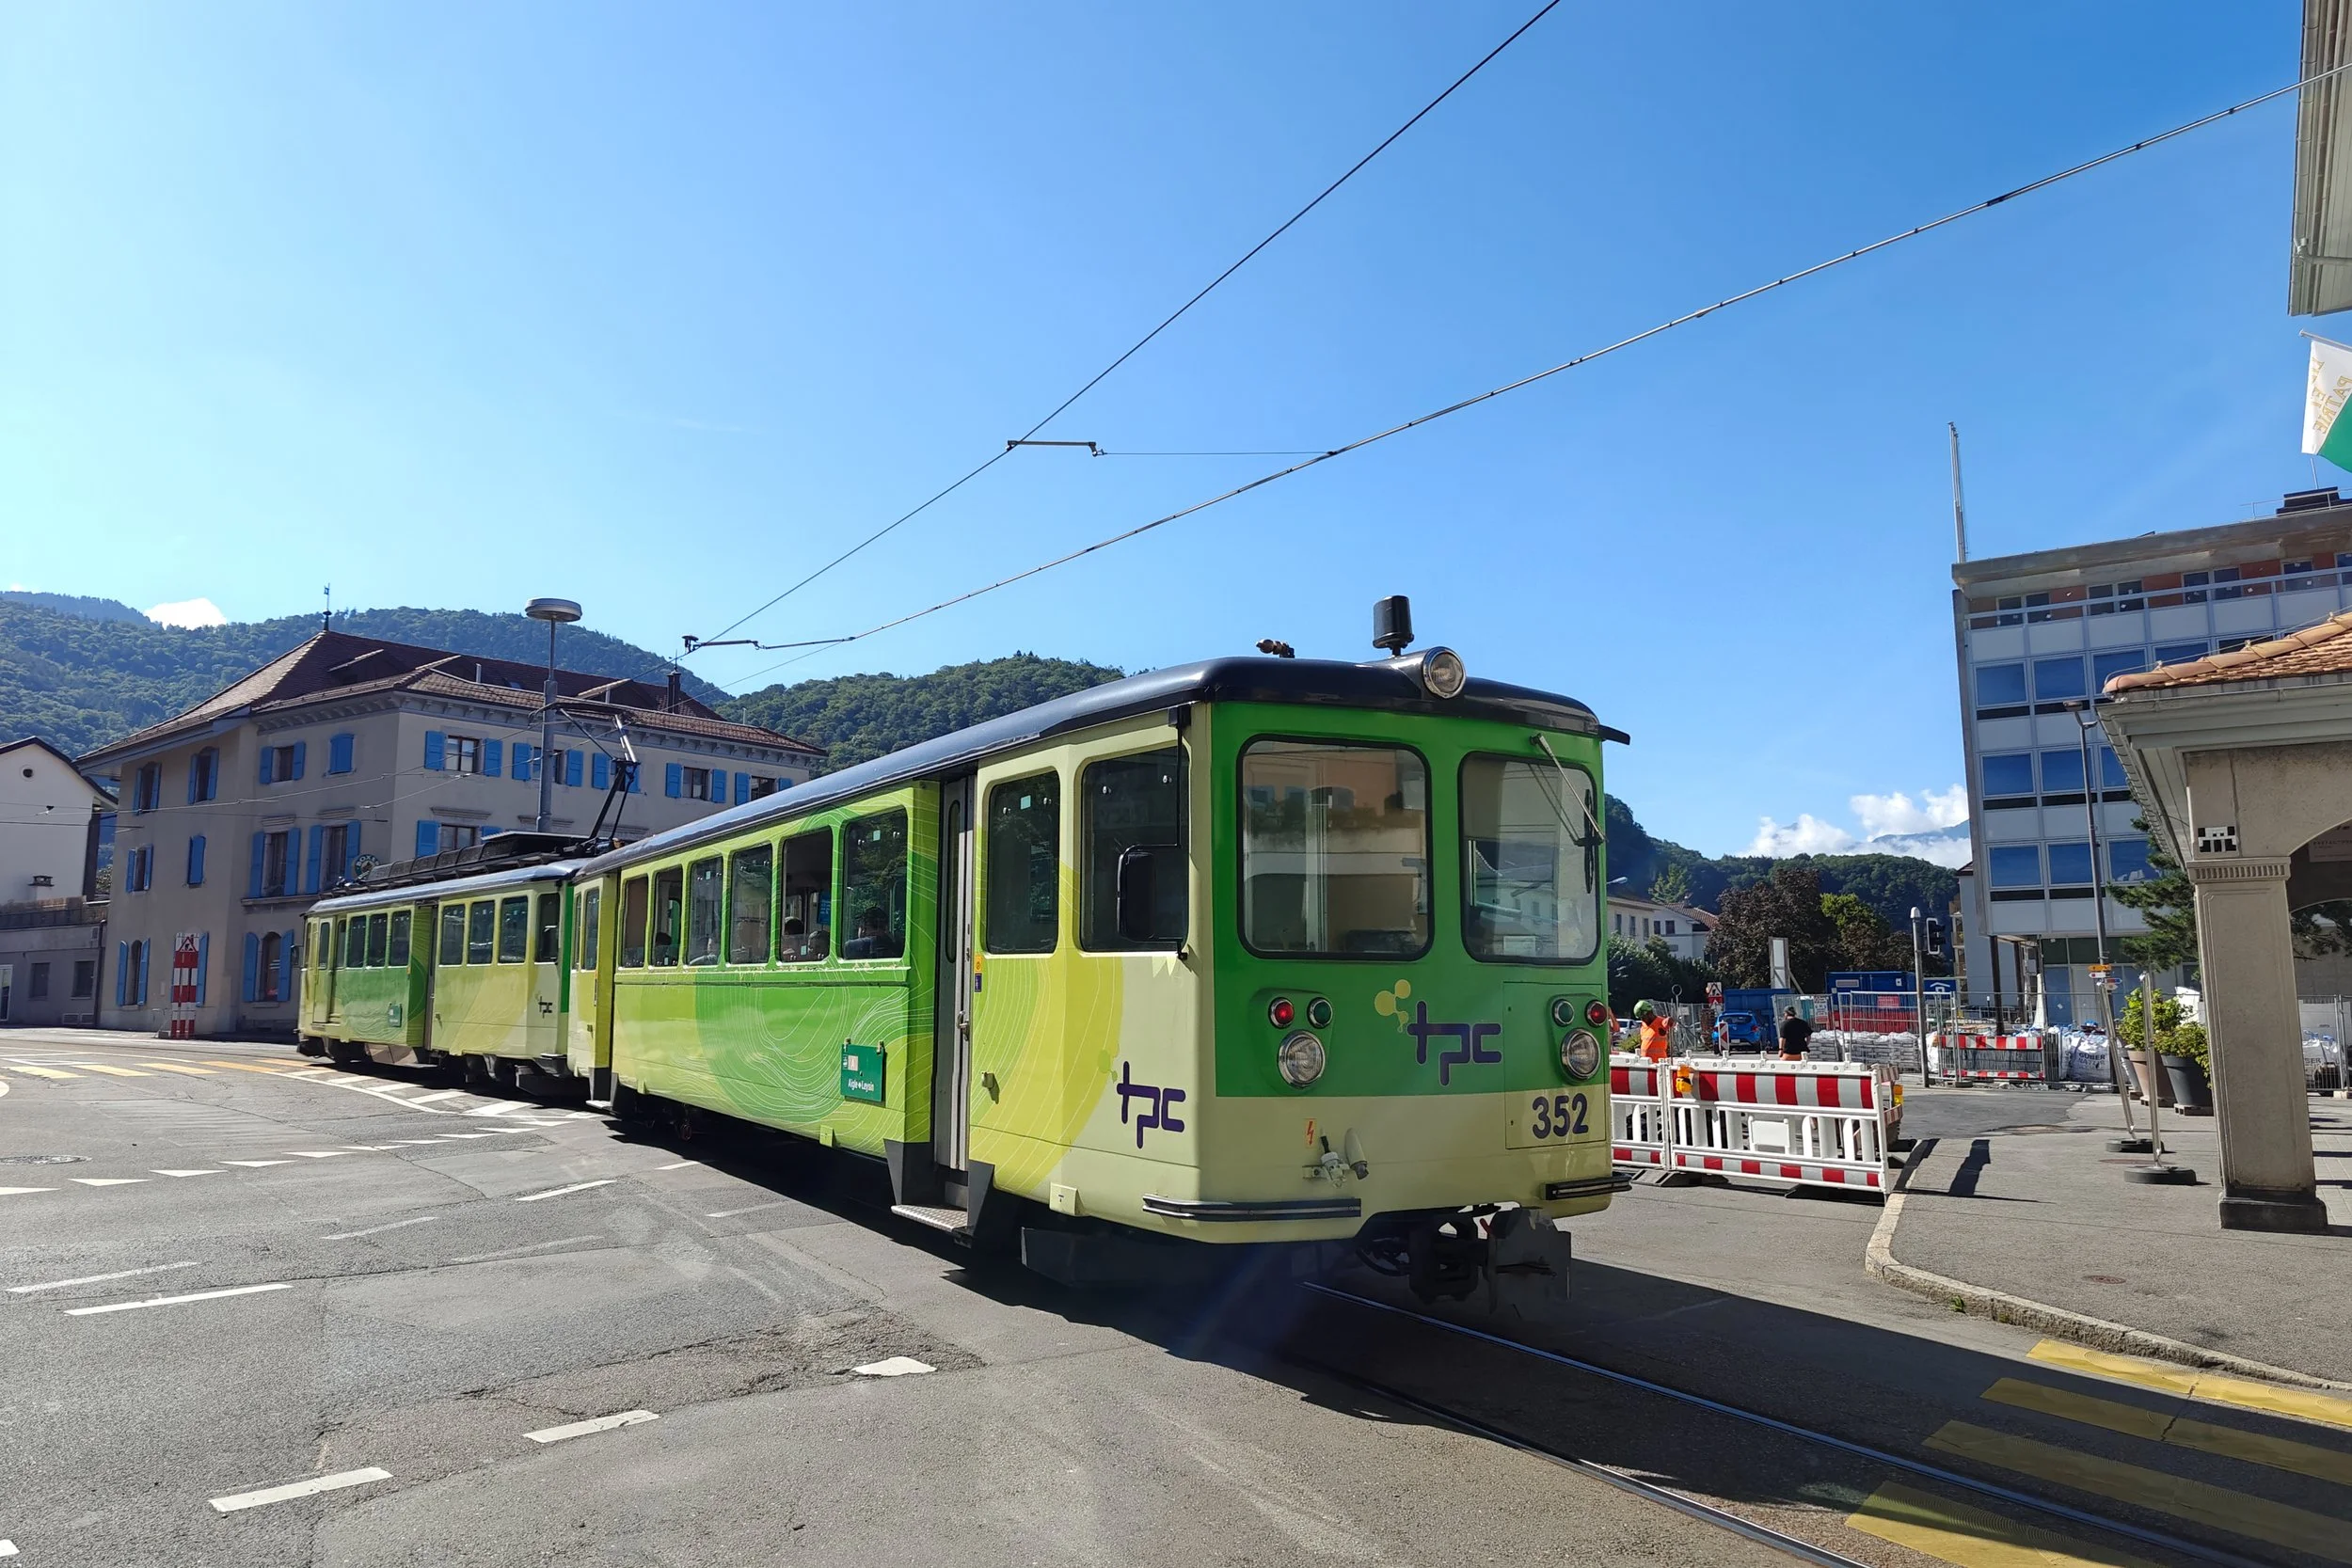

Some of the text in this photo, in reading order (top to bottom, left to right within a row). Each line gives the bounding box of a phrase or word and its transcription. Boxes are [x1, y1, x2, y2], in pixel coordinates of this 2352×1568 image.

[1407, 1001, 1502, 1085] tpc
[1117, 1061, 1186, 1148] tpc
[1533, 1093, 1589, 1139] 352
